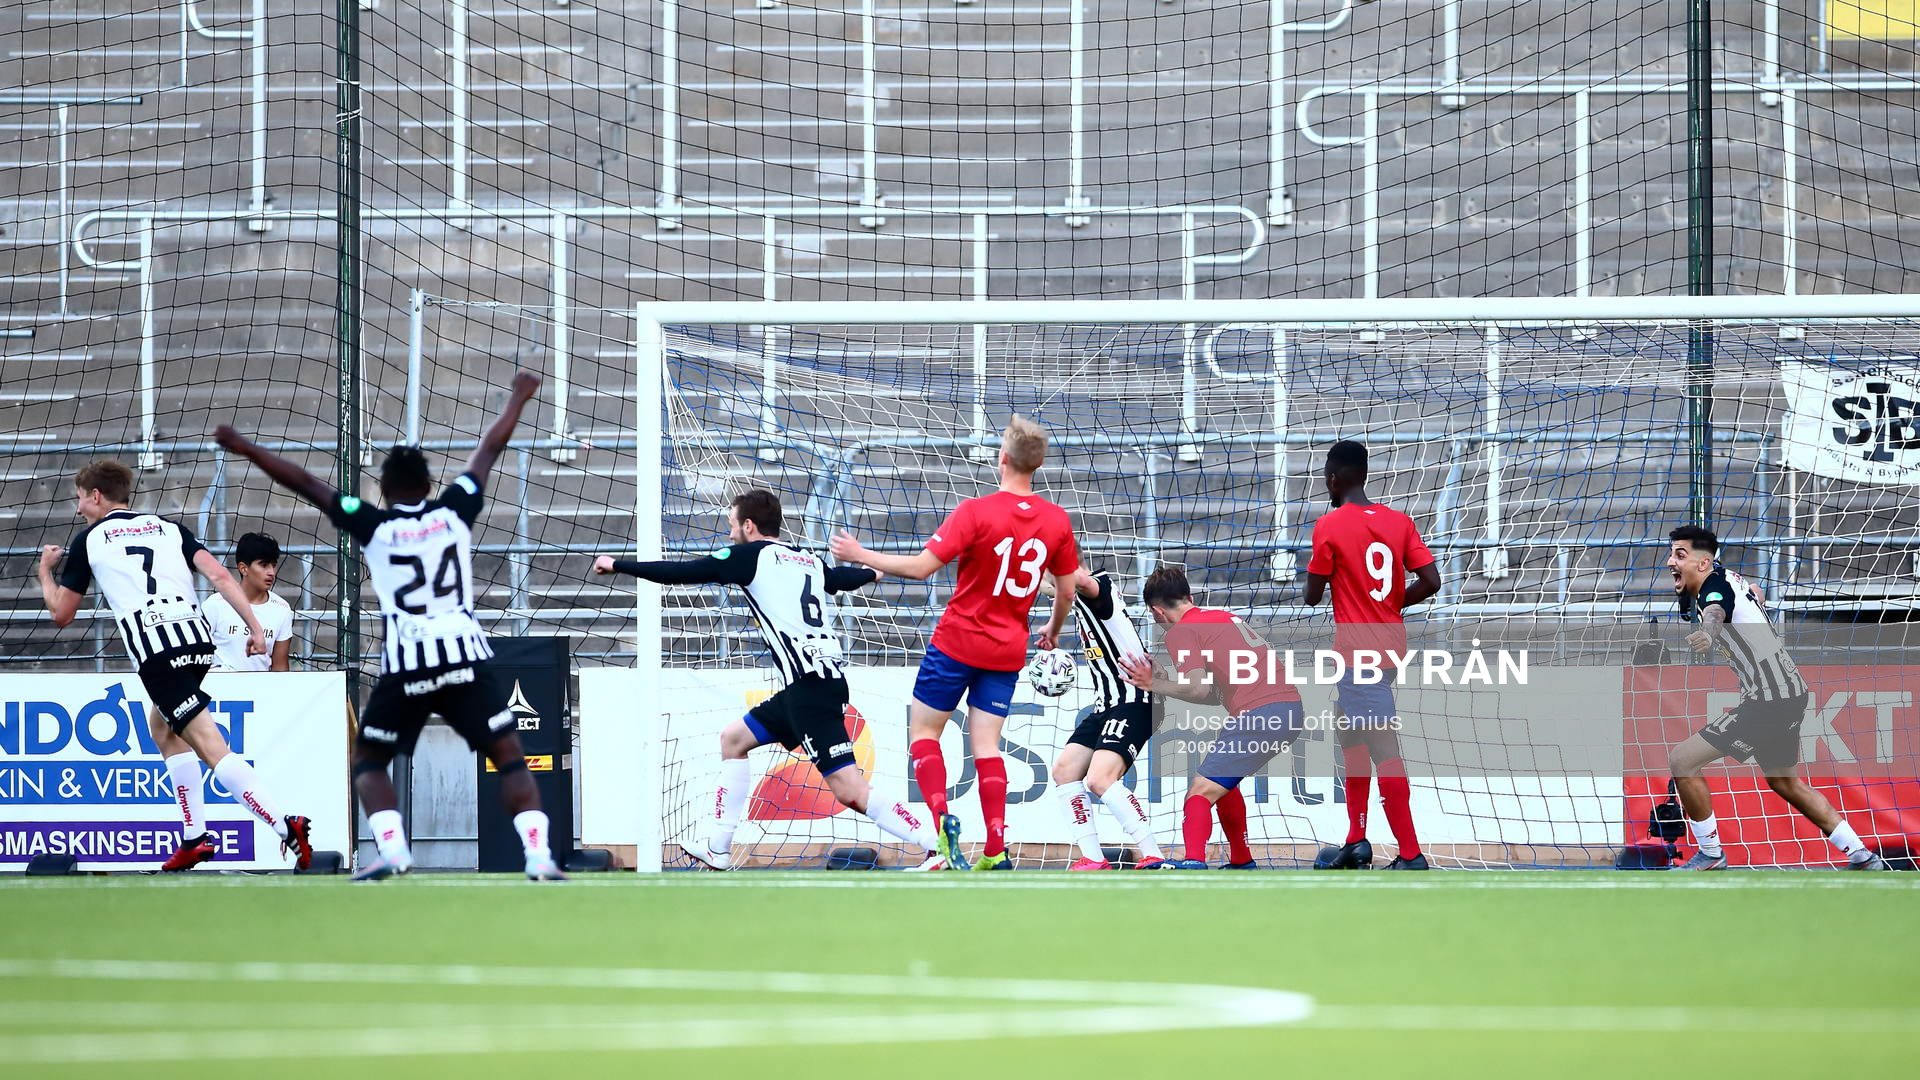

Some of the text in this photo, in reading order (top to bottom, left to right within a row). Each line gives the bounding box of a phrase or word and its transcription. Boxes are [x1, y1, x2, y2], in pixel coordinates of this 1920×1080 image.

[125, 546, 157, 595] 7
[389, 542, 463, 615] 24
[992, 537, 1048, 598] 13
[1365, 541, 1393, 602] 9
[800, 573, 824, 628] 6
[228, 625, 238, 635] IF
[169, 654, 215, 669] HOLME
[400, 667, 475, 696] HOLMEN
[58, 768, 83, 798] &
[91, 768, 233, 798] VERK
[0, 830, 240, 854] MASKINSERVCE
